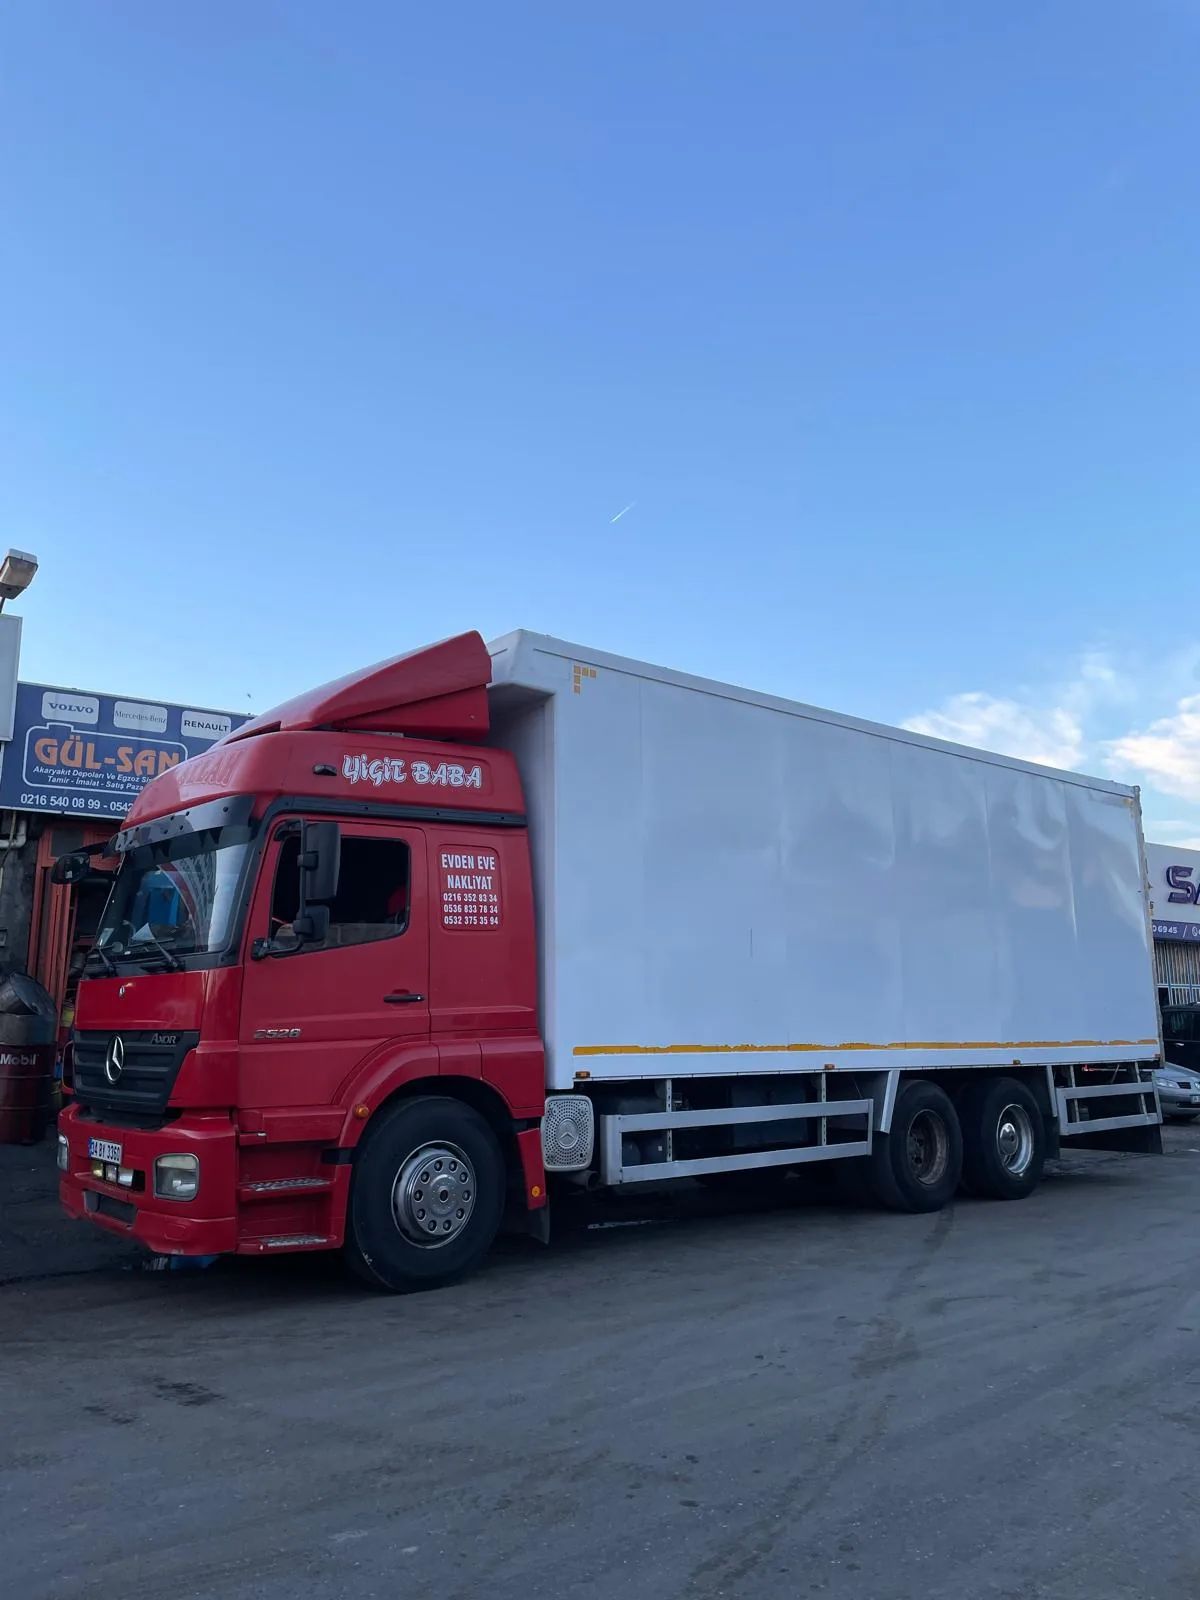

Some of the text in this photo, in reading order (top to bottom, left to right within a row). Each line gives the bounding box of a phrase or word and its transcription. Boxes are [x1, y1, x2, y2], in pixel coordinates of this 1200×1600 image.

[48, 702, 94, 714] VOLVO
[114, 709, 167, 724] Mercedes-Benz
[184, 719, 229, 732] RENAULT
[34, 735, 180, 776] GÜL-SAN
[33, 766, 71, 776] Akaryakıt
[72, 769, 104, 779] Depoları
[106, 772, 116, 780] Ve
[117, 774, 140, 782] Egzoz
[411, 760, 482, 788] BABA
[47, 775, 69, 784] Tamir
[106, 780, 124, 790] Satış
[20, 793, 47, 805] 0216
[50, 796, 69, 807] 540
[72, 797, 85, 809] 08
[87, 799, 101, 810] 99
[441, 854, 496, 870] EVDEN EVE
[1166, 865, 1200, 906] S
[443, 893, 498, 903] 0216 352 83 34
[443, 904, 498, 914] 0536 833 78 34
[444, 915, 499, 925] 0532 375 35 94
[254, 1028, 301, 1039] 2528
[0, 1053, 37, 1065] Mobil
